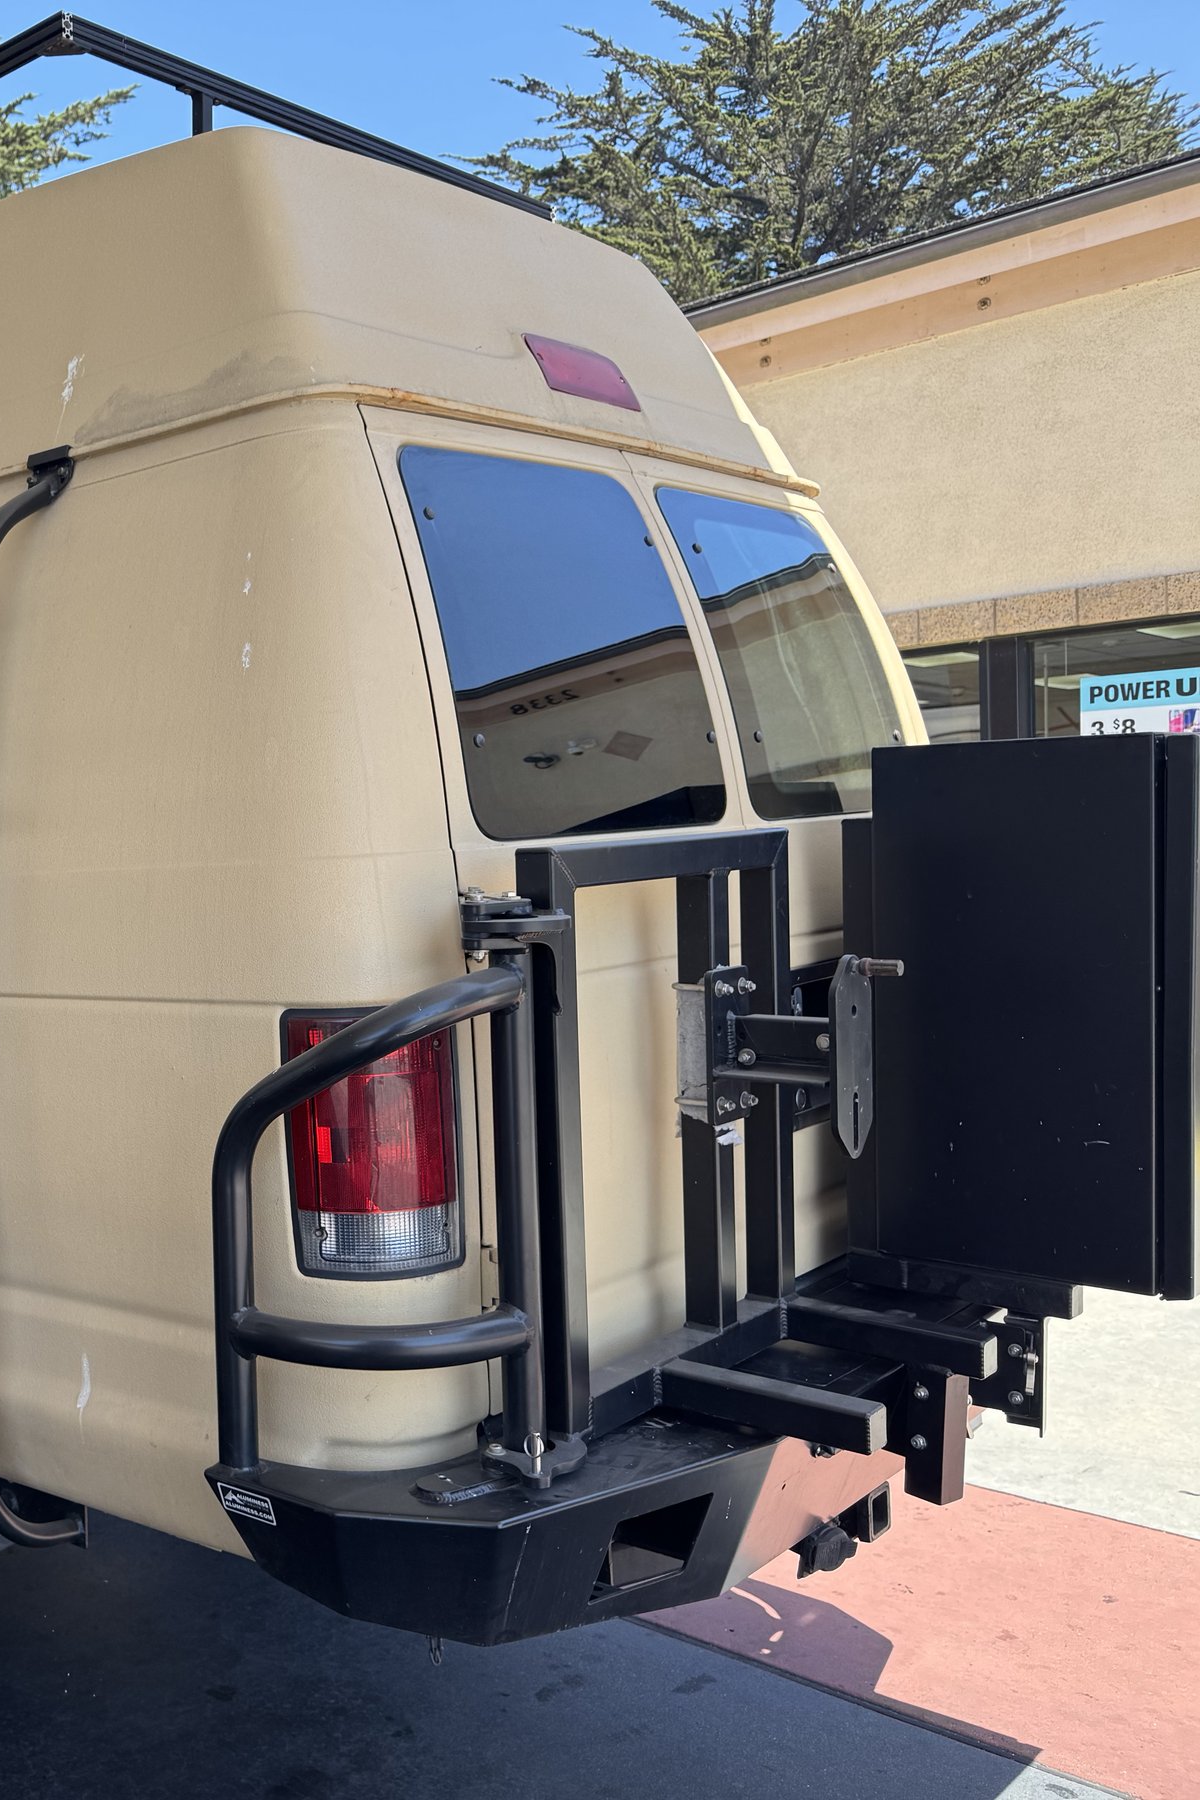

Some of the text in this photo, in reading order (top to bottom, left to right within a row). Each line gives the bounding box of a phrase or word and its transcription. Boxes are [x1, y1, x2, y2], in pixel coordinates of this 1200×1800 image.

[1089, 677, 1200, 704] POWER U
[225, 1500, 273, 1520] ALUMINESS.COM
[236, 1493, 269, 1508] ALUMINESS
